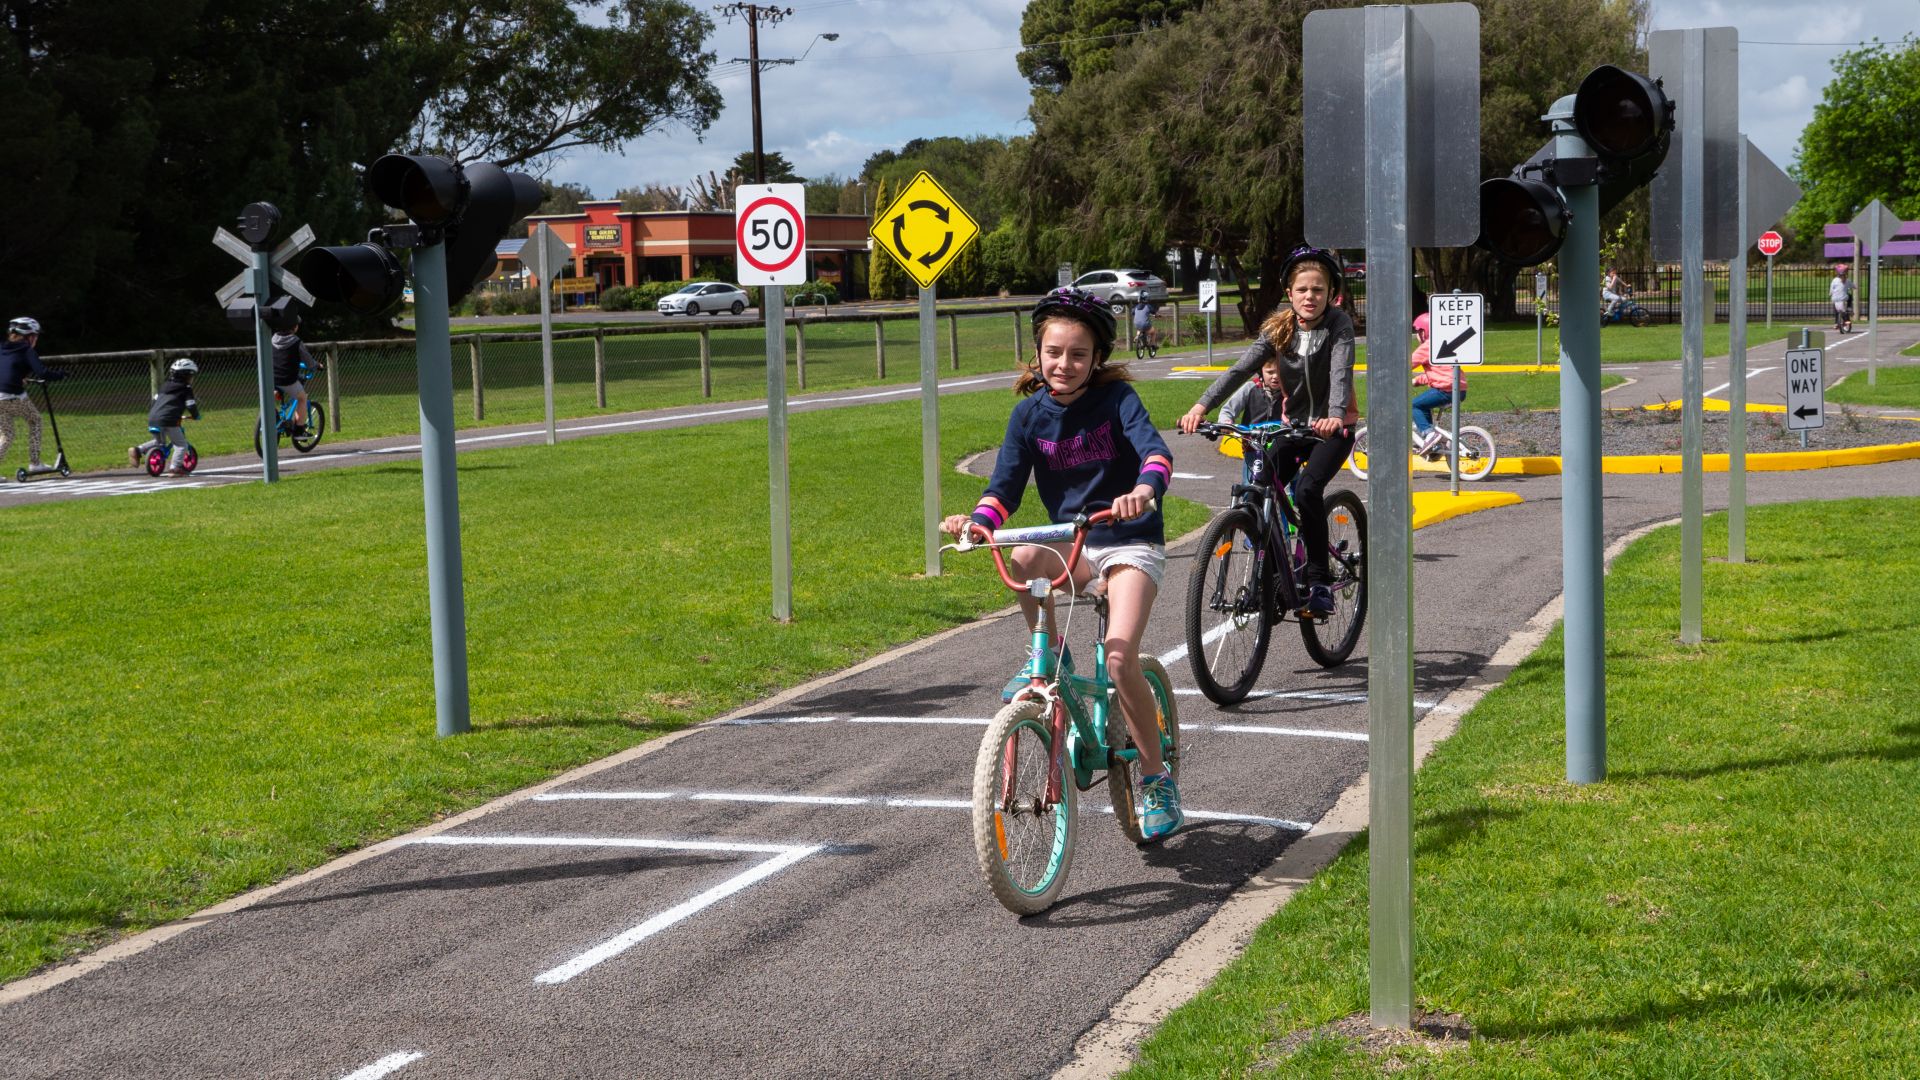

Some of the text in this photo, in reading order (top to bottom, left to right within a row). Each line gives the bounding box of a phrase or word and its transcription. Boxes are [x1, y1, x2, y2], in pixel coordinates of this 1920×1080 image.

[751, 218, 793, 250] 50
[1760, 238, 1780, 248] STOP
[1439, 300, 1473, 311] KEEP
[1440, 315, 1472, 326] LEFT
[1791, 357, 1817, 374] ONE
[1791, 378, 1818, 394] WAY
